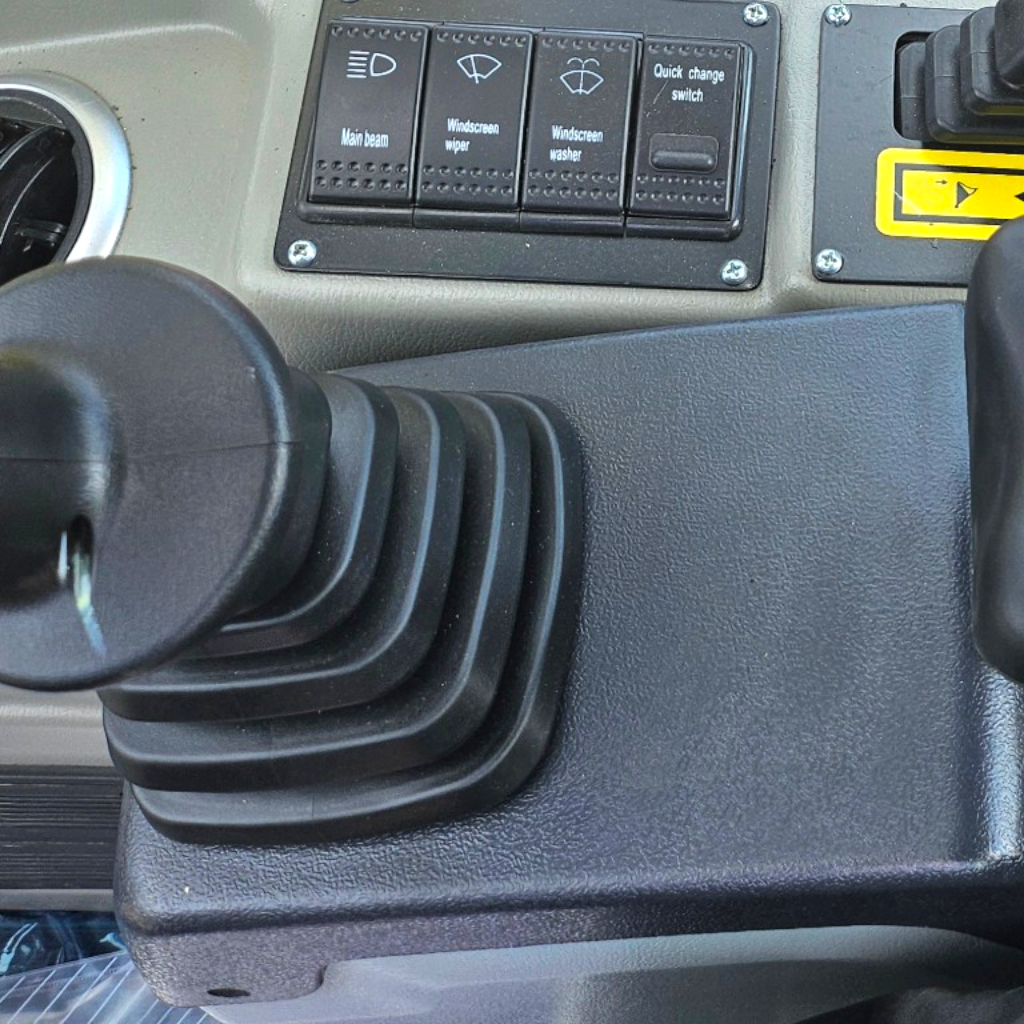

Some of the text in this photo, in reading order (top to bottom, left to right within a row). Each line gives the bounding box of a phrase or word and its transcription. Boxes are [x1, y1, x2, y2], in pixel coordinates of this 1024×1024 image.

[654, 63, 725, 85] Quick change
[671, 87, 704, 102] switch
[447, 118, 500, 136] Windscreen
[551, 125, 604, 143] Windscreen
[340, 128, 389, 149] Main beam
[444, 138, 470, 155] wiper
[549, 147, 582, 162] washer
